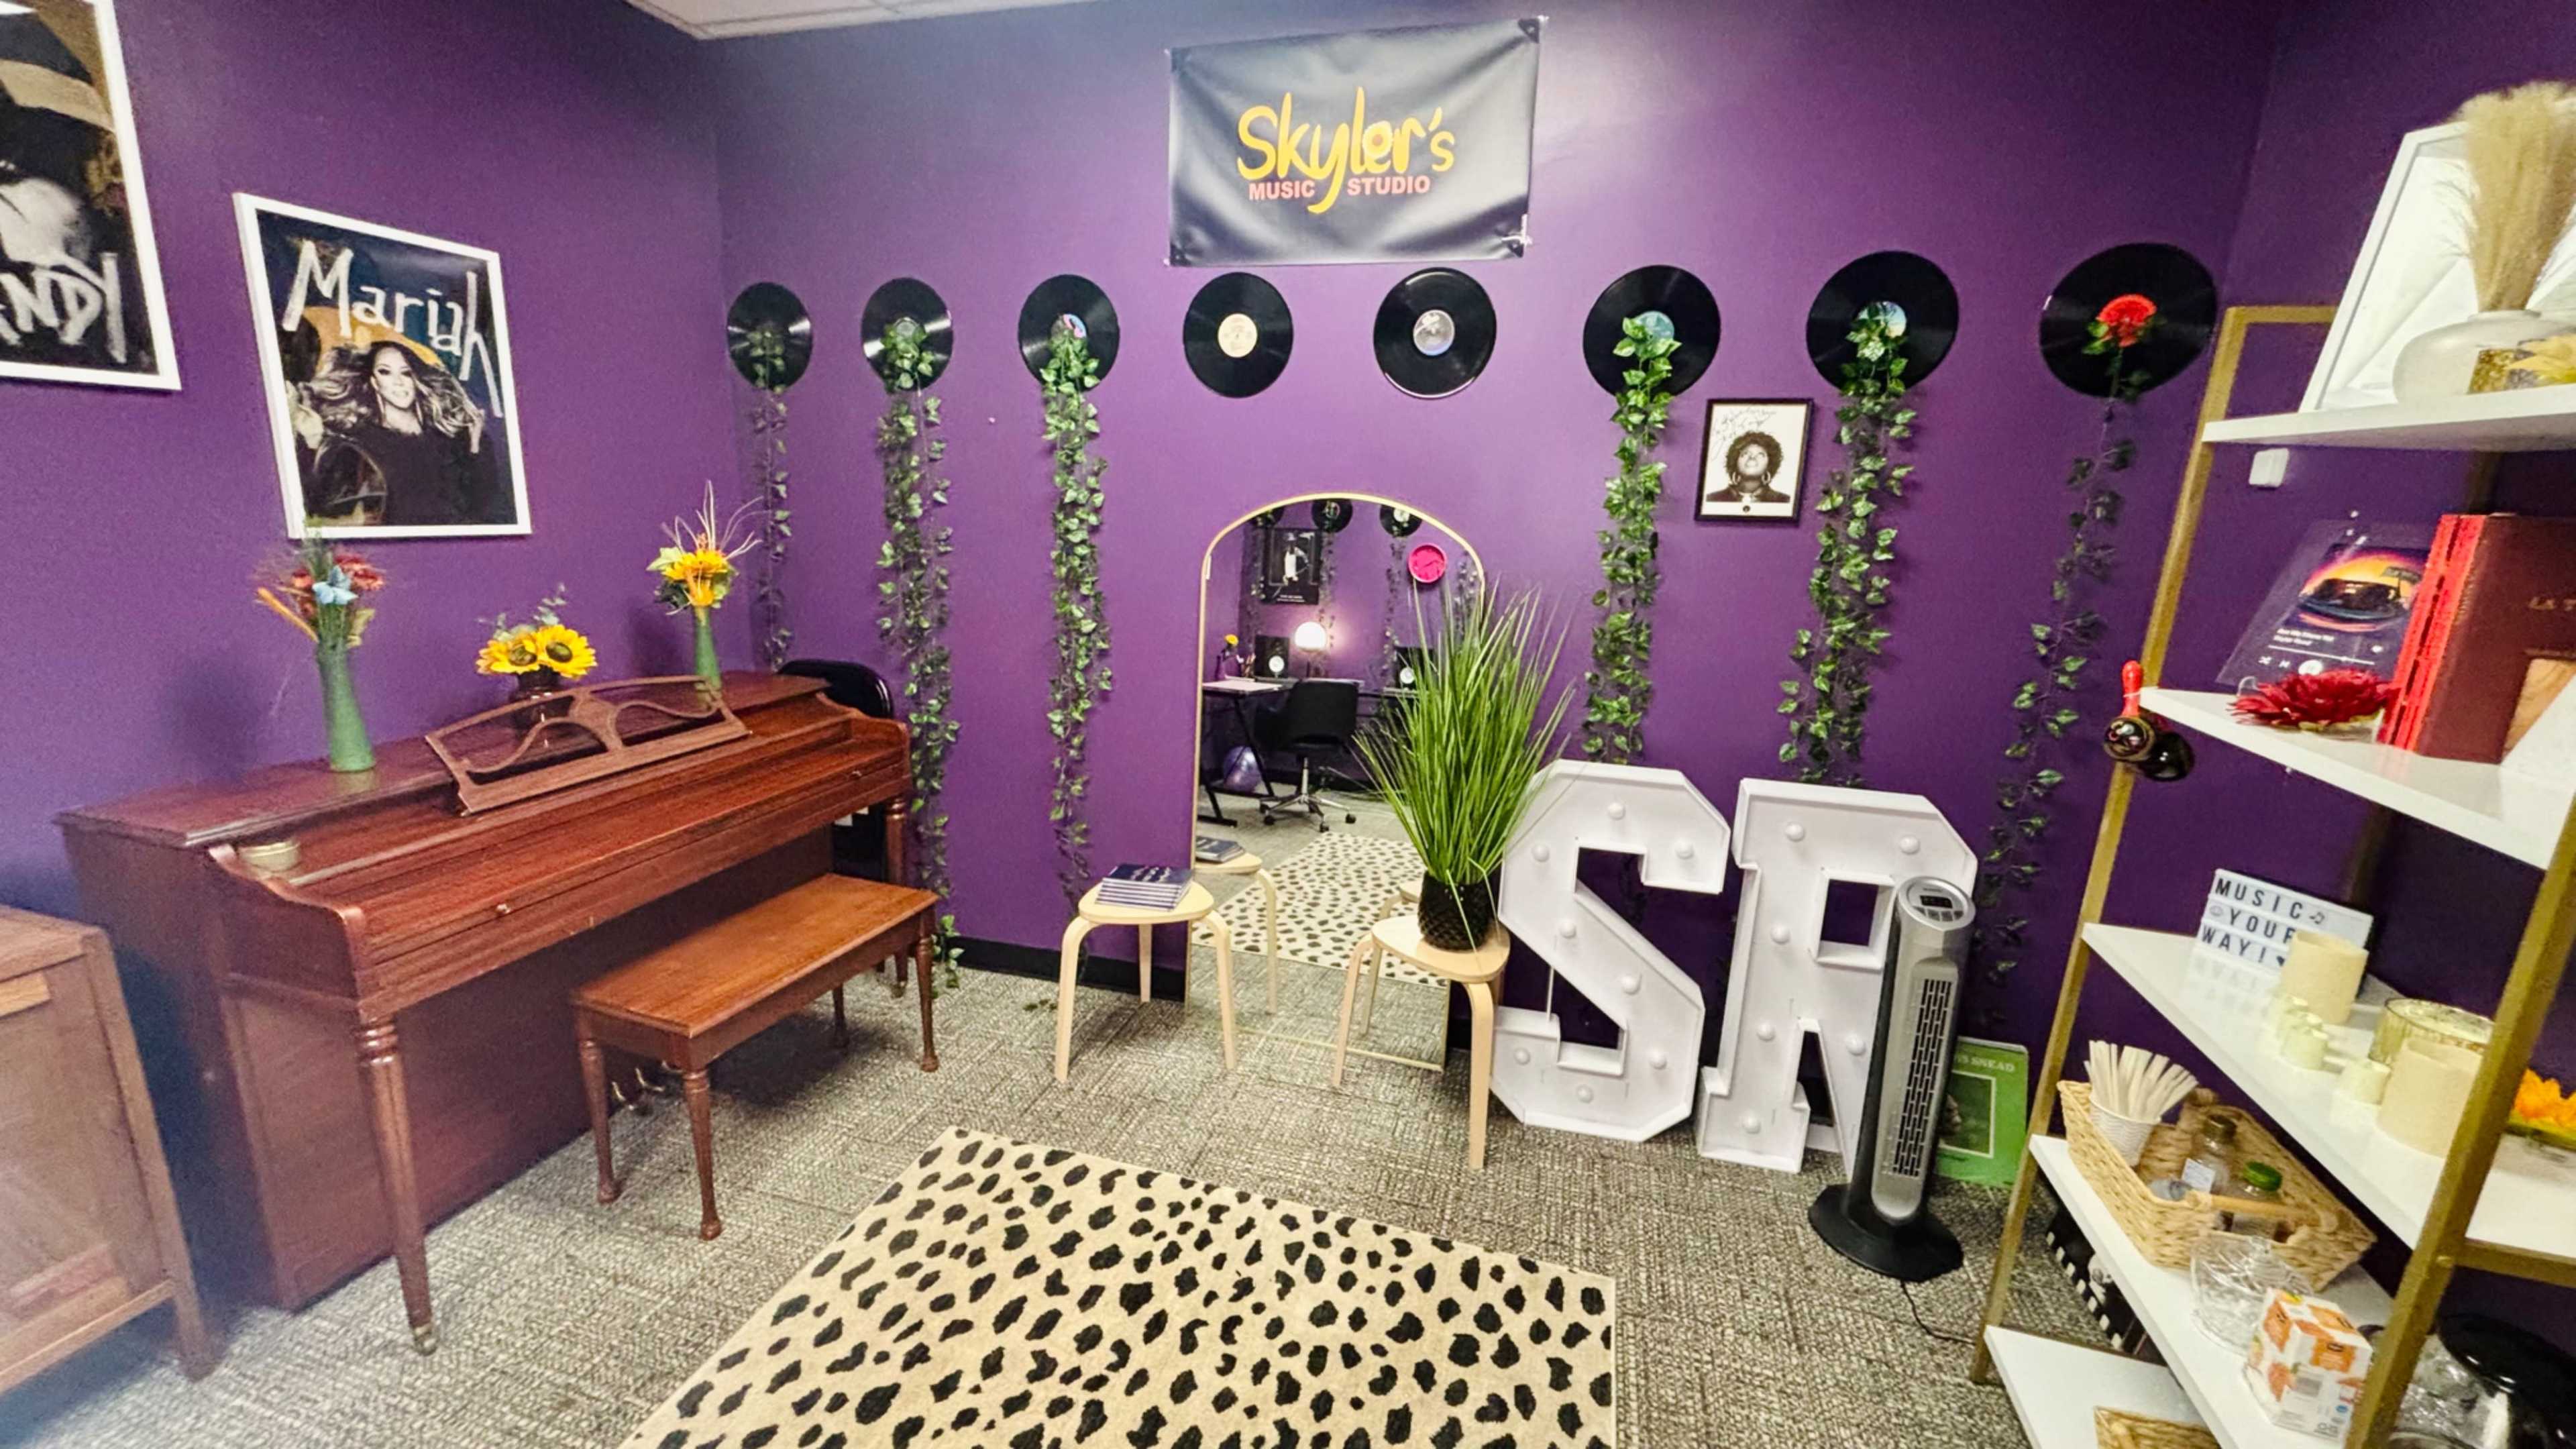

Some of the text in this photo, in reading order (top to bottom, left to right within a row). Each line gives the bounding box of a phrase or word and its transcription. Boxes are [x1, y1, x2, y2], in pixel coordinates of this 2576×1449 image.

[1237, 87, 1455, 213] Skyler's
[1248, 176, 1431, 200] MUSIC STUDIO
[282, 239, 503, 417] Mariah
[2215, 878, 2303, 919] MUSIC
[2201, 924, 2266, 963] WAY!
